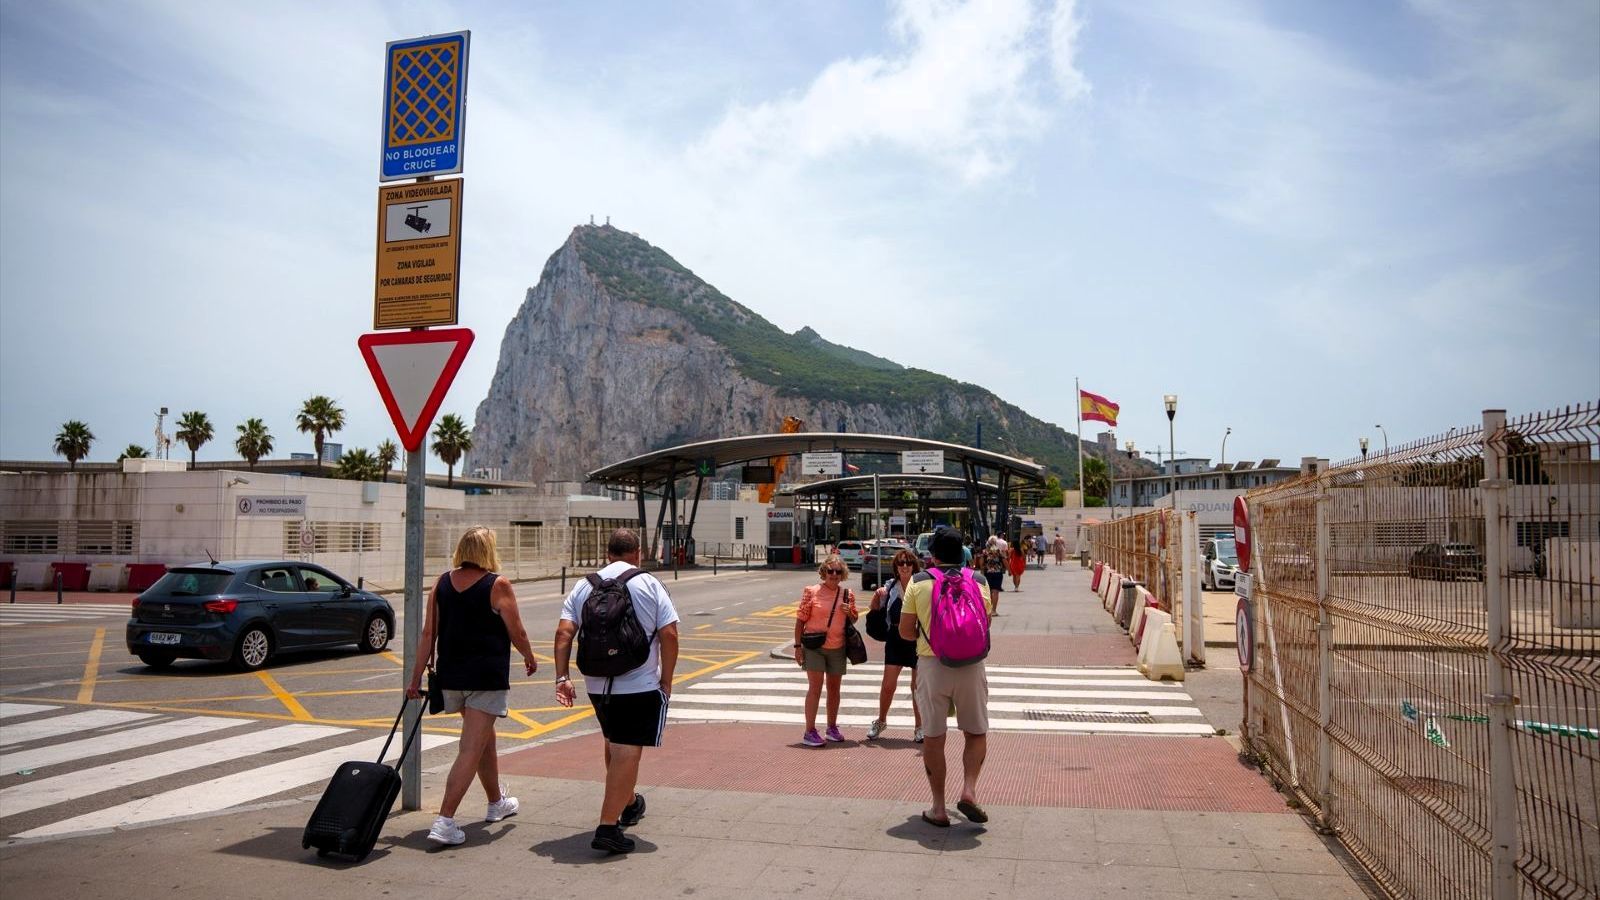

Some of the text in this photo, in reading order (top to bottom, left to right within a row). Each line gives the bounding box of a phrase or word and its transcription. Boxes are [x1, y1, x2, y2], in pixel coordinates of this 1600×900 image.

[385, 144, 455, 161] NO BLOQUEAR
[403, 159, 436, 170] CRUCE
[386, 185, 453, 200] ZONA VIDEOVIGILADA
[397, 259, 435, 270] ZONA VIGILADA
[380, 273, 452, 287] POR CAMARAS DE SEGURIDAD
[1190, 502, 1234, 512] ADUAN
